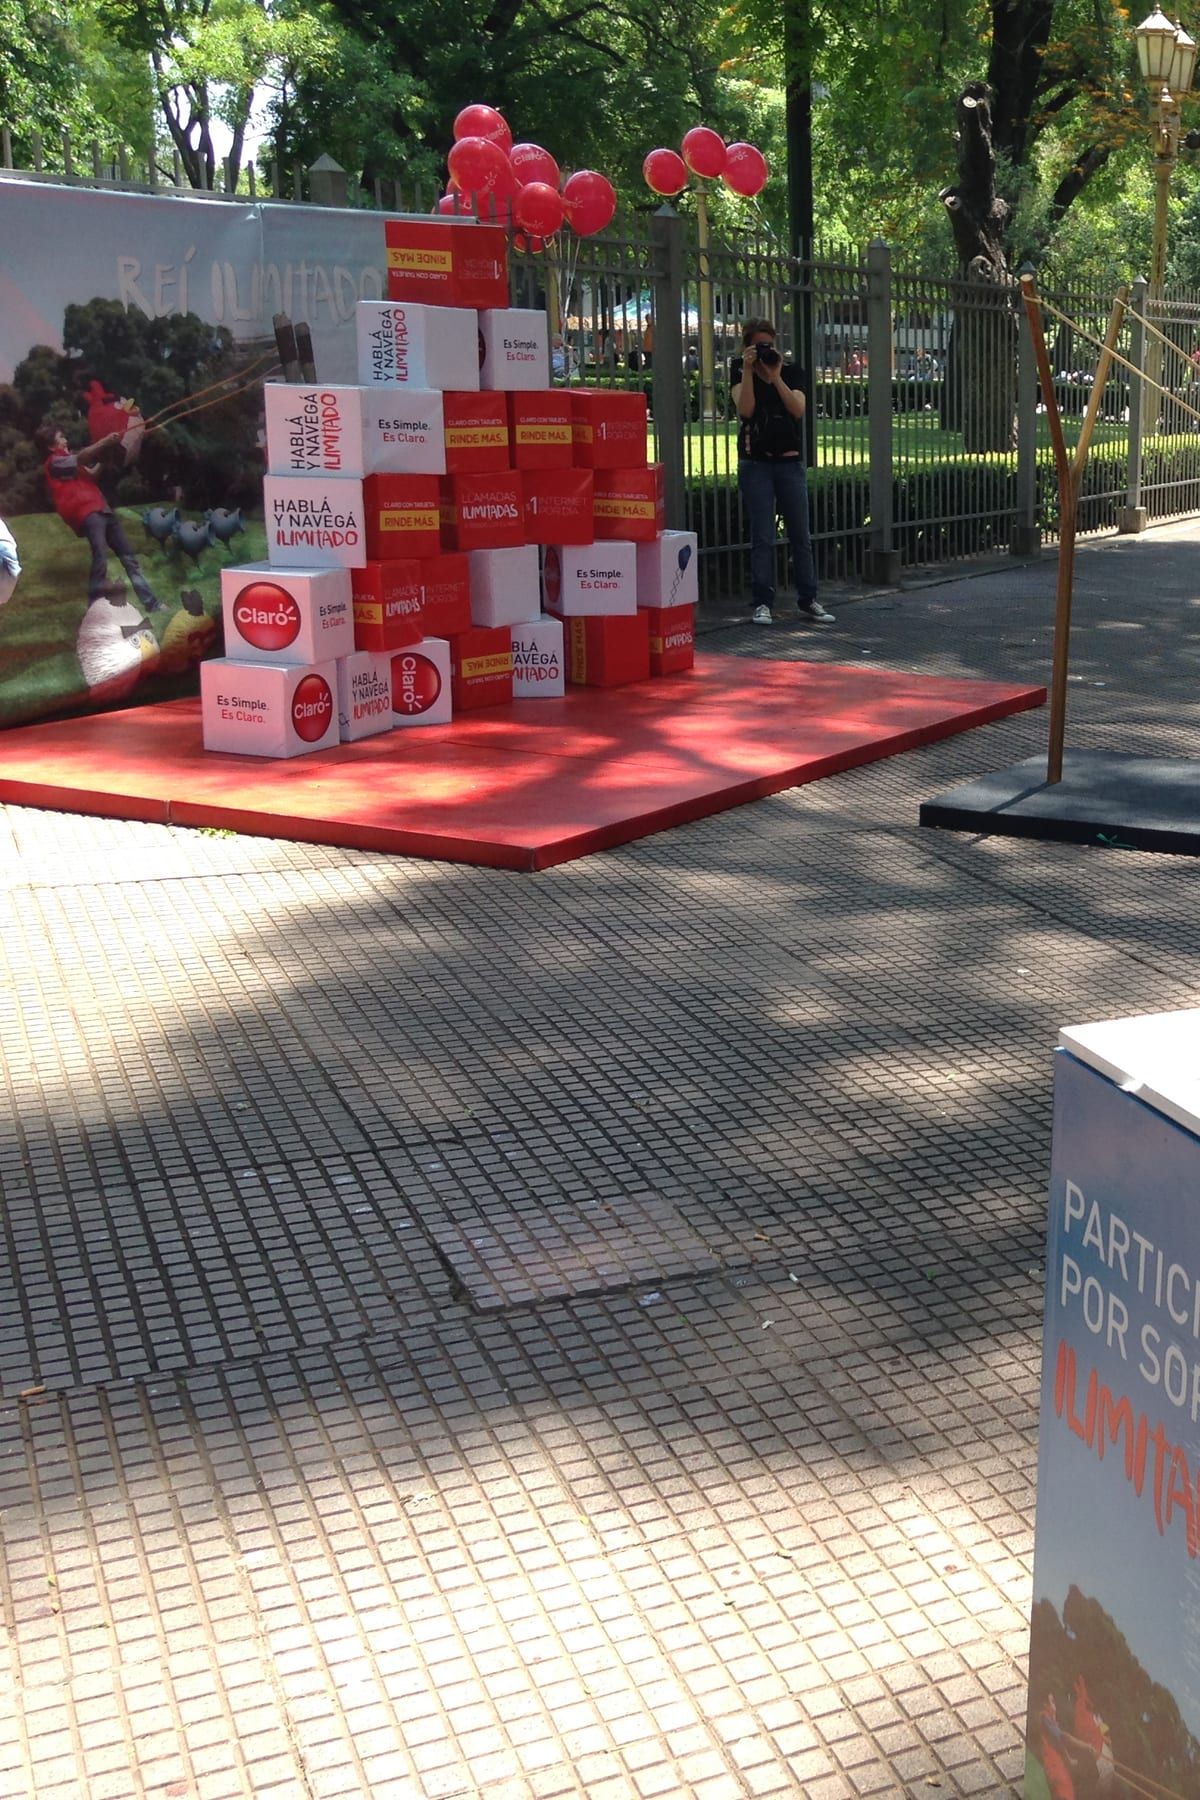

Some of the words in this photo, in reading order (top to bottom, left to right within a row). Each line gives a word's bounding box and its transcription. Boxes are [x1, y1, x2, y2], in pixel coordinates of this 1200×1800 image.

[417, 253, 447, 265] RINDE
[117, 244, 196, 321] REÍ
[380, 308, 394, 368] NAVEGÁ
[393, 308, 408, 382] ILIMITADO
[504, 339, 512, 349] Es
[513, 338, 539, 351] Simple.
[371, 329, 382, 381] HABLÁ
[506, 352, 515, 361] Es
[516, 351, 537, 361] Claro.
[383, 373, 394, 382] Y
[301, 393, 320, 457] NAVEGÁ
[320, 392, 342, 470] ILIMITADO
[379, 419, 391, 430] Es
[393, 418, 431, 432] Simple.
[286, 416, 306, 470] HABLÁ
[383, 432, 396, 443] Es
[449, 433, 480, 444] RINDE
[520, 430, 547, 441] RINDE
[306, 460, 321, 471] Y
[274, 497, 331, 513] HABLÁ
[462, 492, 517, 503] LLAMADAS
[462, 503, 519, 521] ILIMITADAS
[594, 503, 620, 515] INDE
[274, 515, 284, 527] Y
[290, 512, 357, 528] NAVEGÁ
[384, 517, 412, 528] RINDE
[276, 530, 358, 549] ILIMITADO
[577, 569, 588, 578] Es
[589, 568, 624, 581] Simple.
[580, 580, 592, 589] Es
[237, 606, 292, 626] Claro
[319, 607, 327, 617] Es
[322, 620, 329, 629] Es
[511, 638, 538, 653] BLÁ
[485, 656, 509, 668] RINDE
[511, 650, 559, 665] AVEGÁ
[352, 671, 378, 688] HABLÁ
[401, 656, 417, 706] Claro
[352, 689, 359, 699] Y
[359, 678, 389, 699] NAVEGÁ
[217, 696, 230, 707] Es
[231, 696, 270, 711] Simple.
[294, 701, 327, 719] Claro
[353, 696, 390, 720] ILIMITADO
[221, 709, 234, 719] Es
[235, 711, 266, 723] Claro.
[1061, 1254, 1129, 1361] POR
